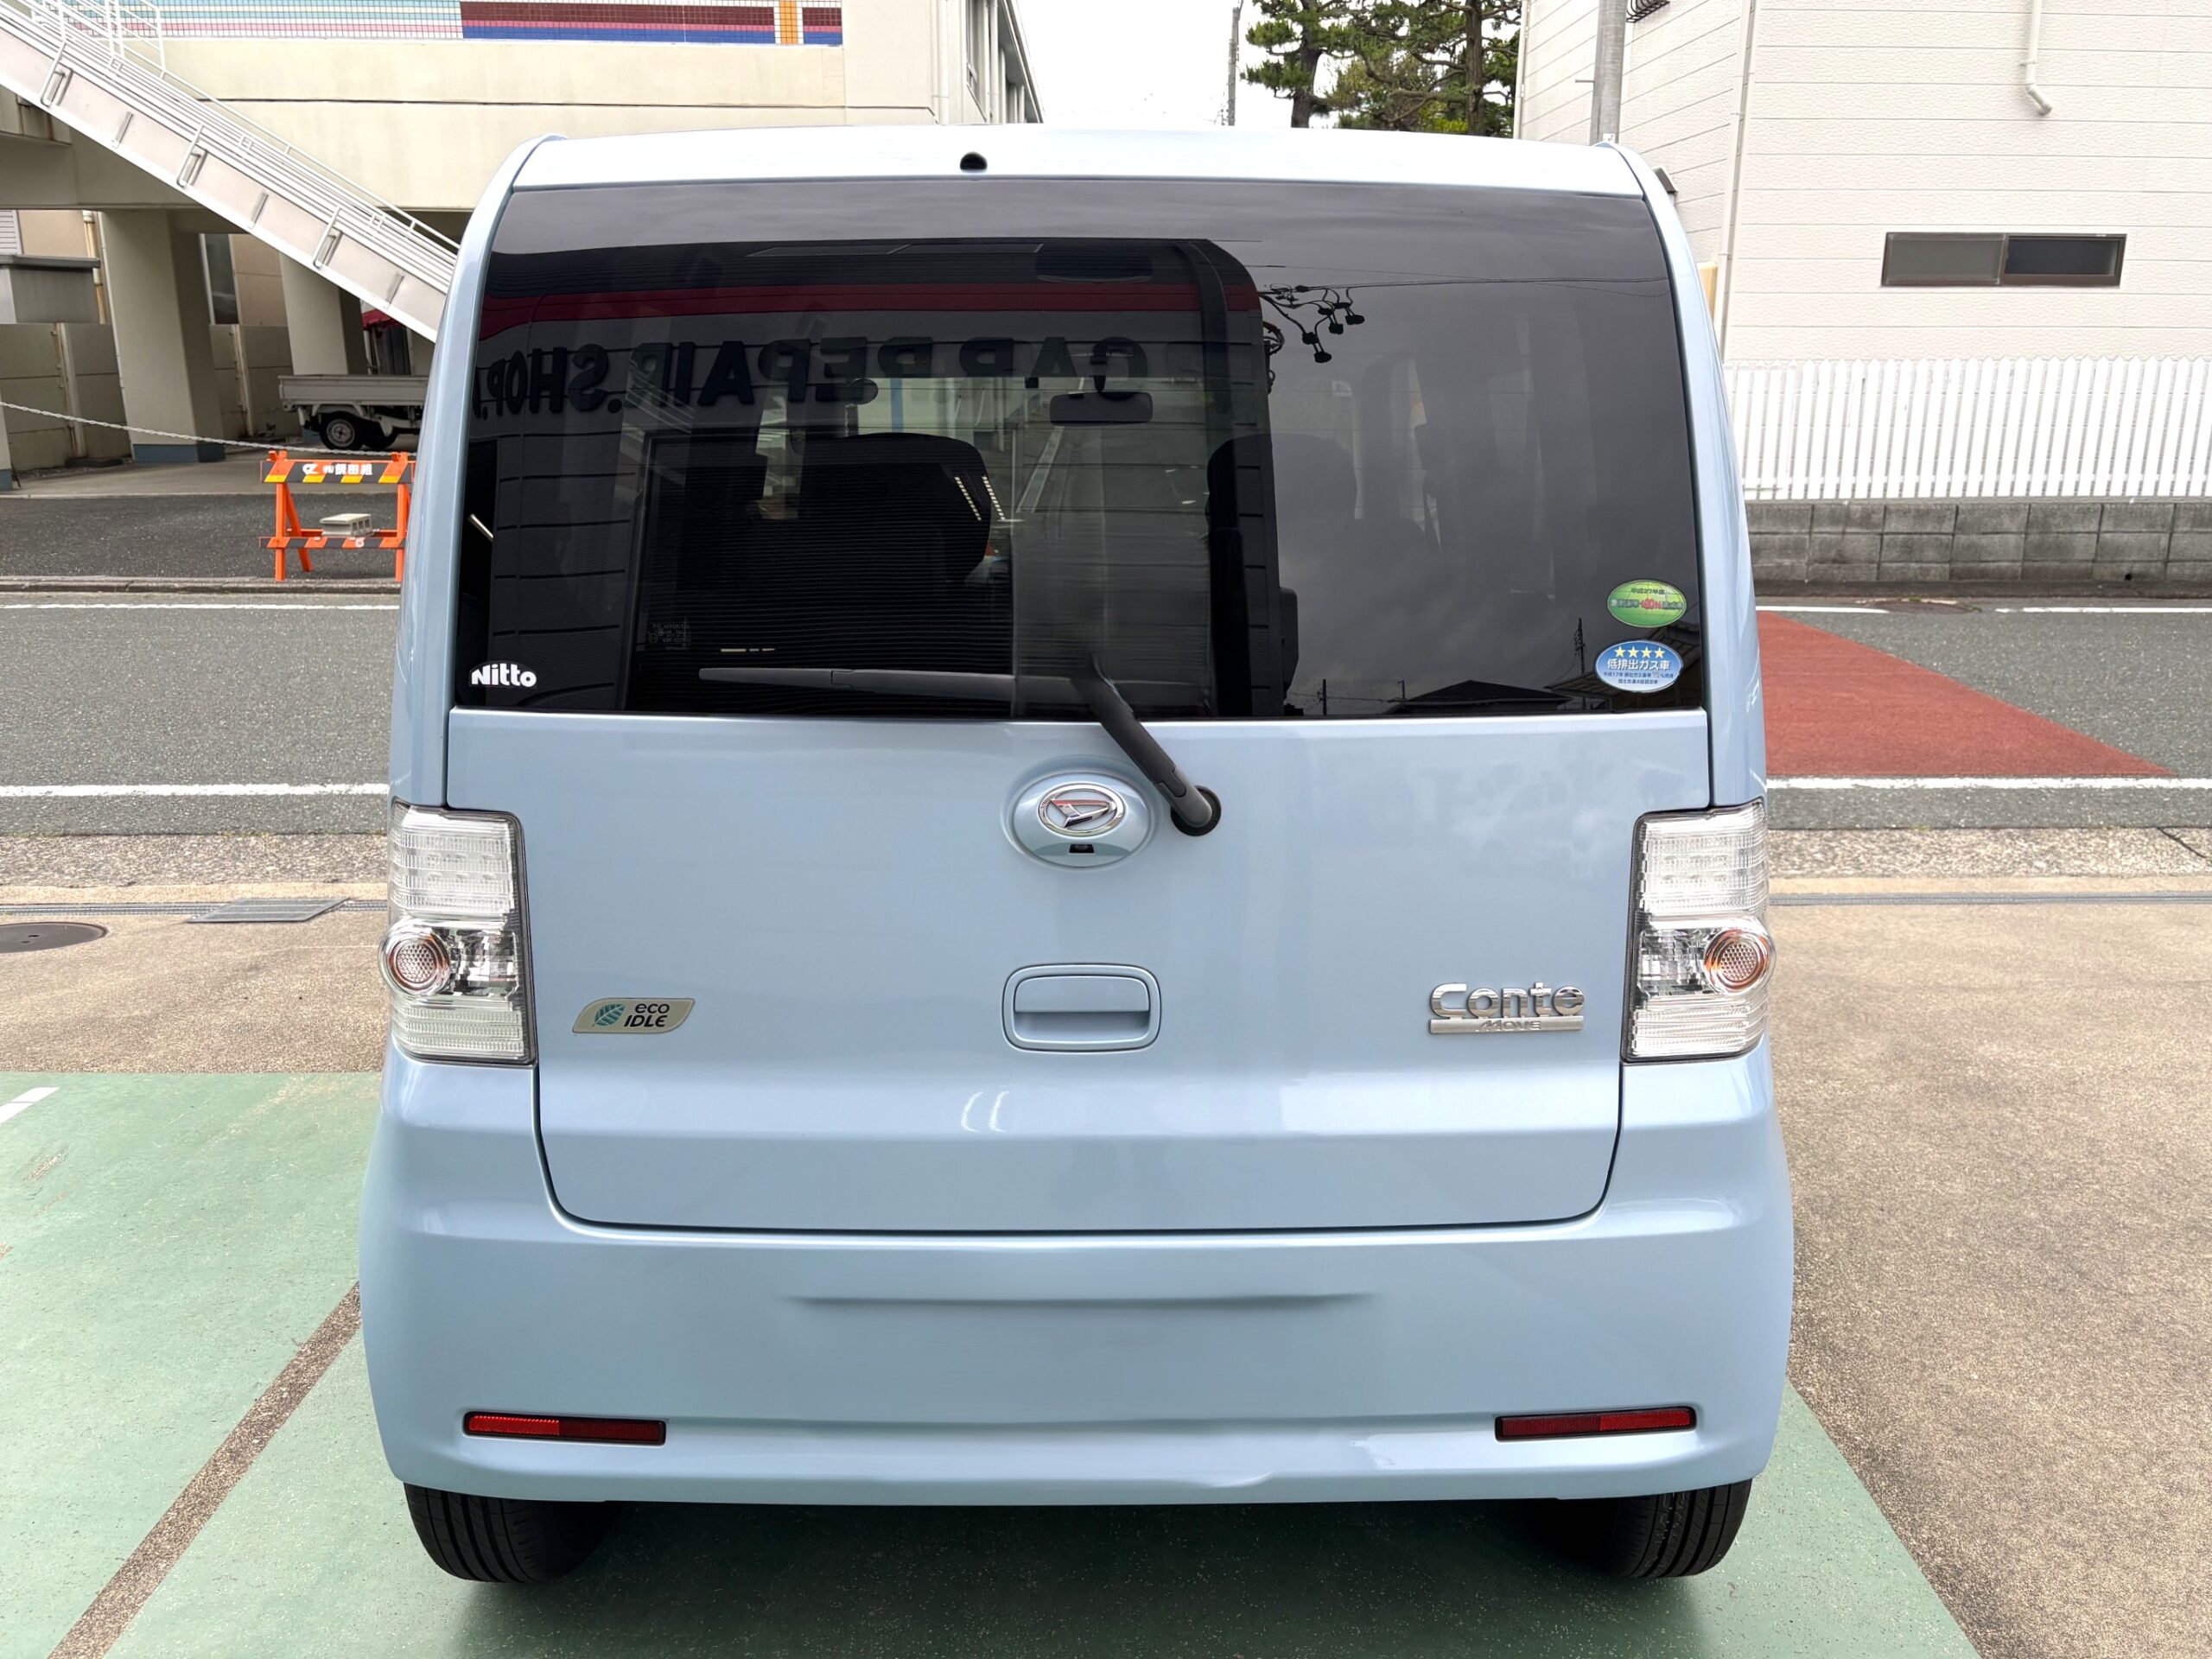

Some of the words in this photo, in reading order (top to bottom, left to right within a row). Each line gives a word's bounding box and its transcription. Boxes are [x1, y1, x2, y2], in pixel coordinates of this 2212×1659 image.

[1607, 658, 1671, 671] 低排出ガス車
[471, 663, 537, 688] Nitto
[1430, 982, 1586, 1019] Conte
[635, 1003, 671, 1014] eco
[624, 1014, 668, 1027] IDLE
[1476, 1020, 1541, 1033] MOVE
